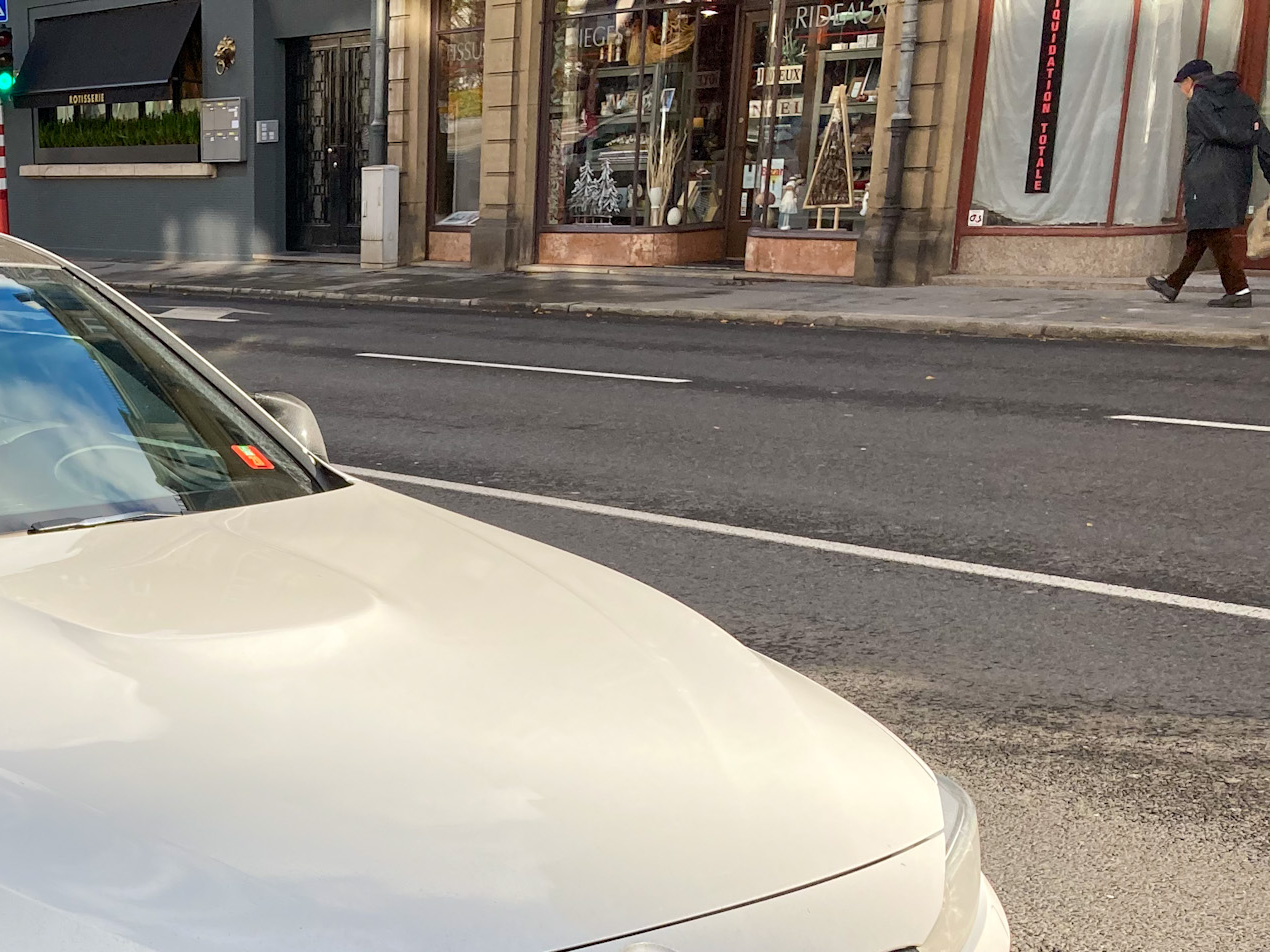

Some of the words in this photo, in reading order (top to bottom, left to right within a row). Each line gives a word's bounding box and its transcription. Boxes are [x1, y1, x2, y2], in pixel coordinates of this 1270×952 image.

[795, 2, 887, 29] RIDEAUX
[446, 41, 485, 62] TISSU
[1042, 0, 1061, 113] IQUIDATION
[68, 93, 105, 105] ROTISSERIE
[1034, 122, 1049, 191] TOTALE
